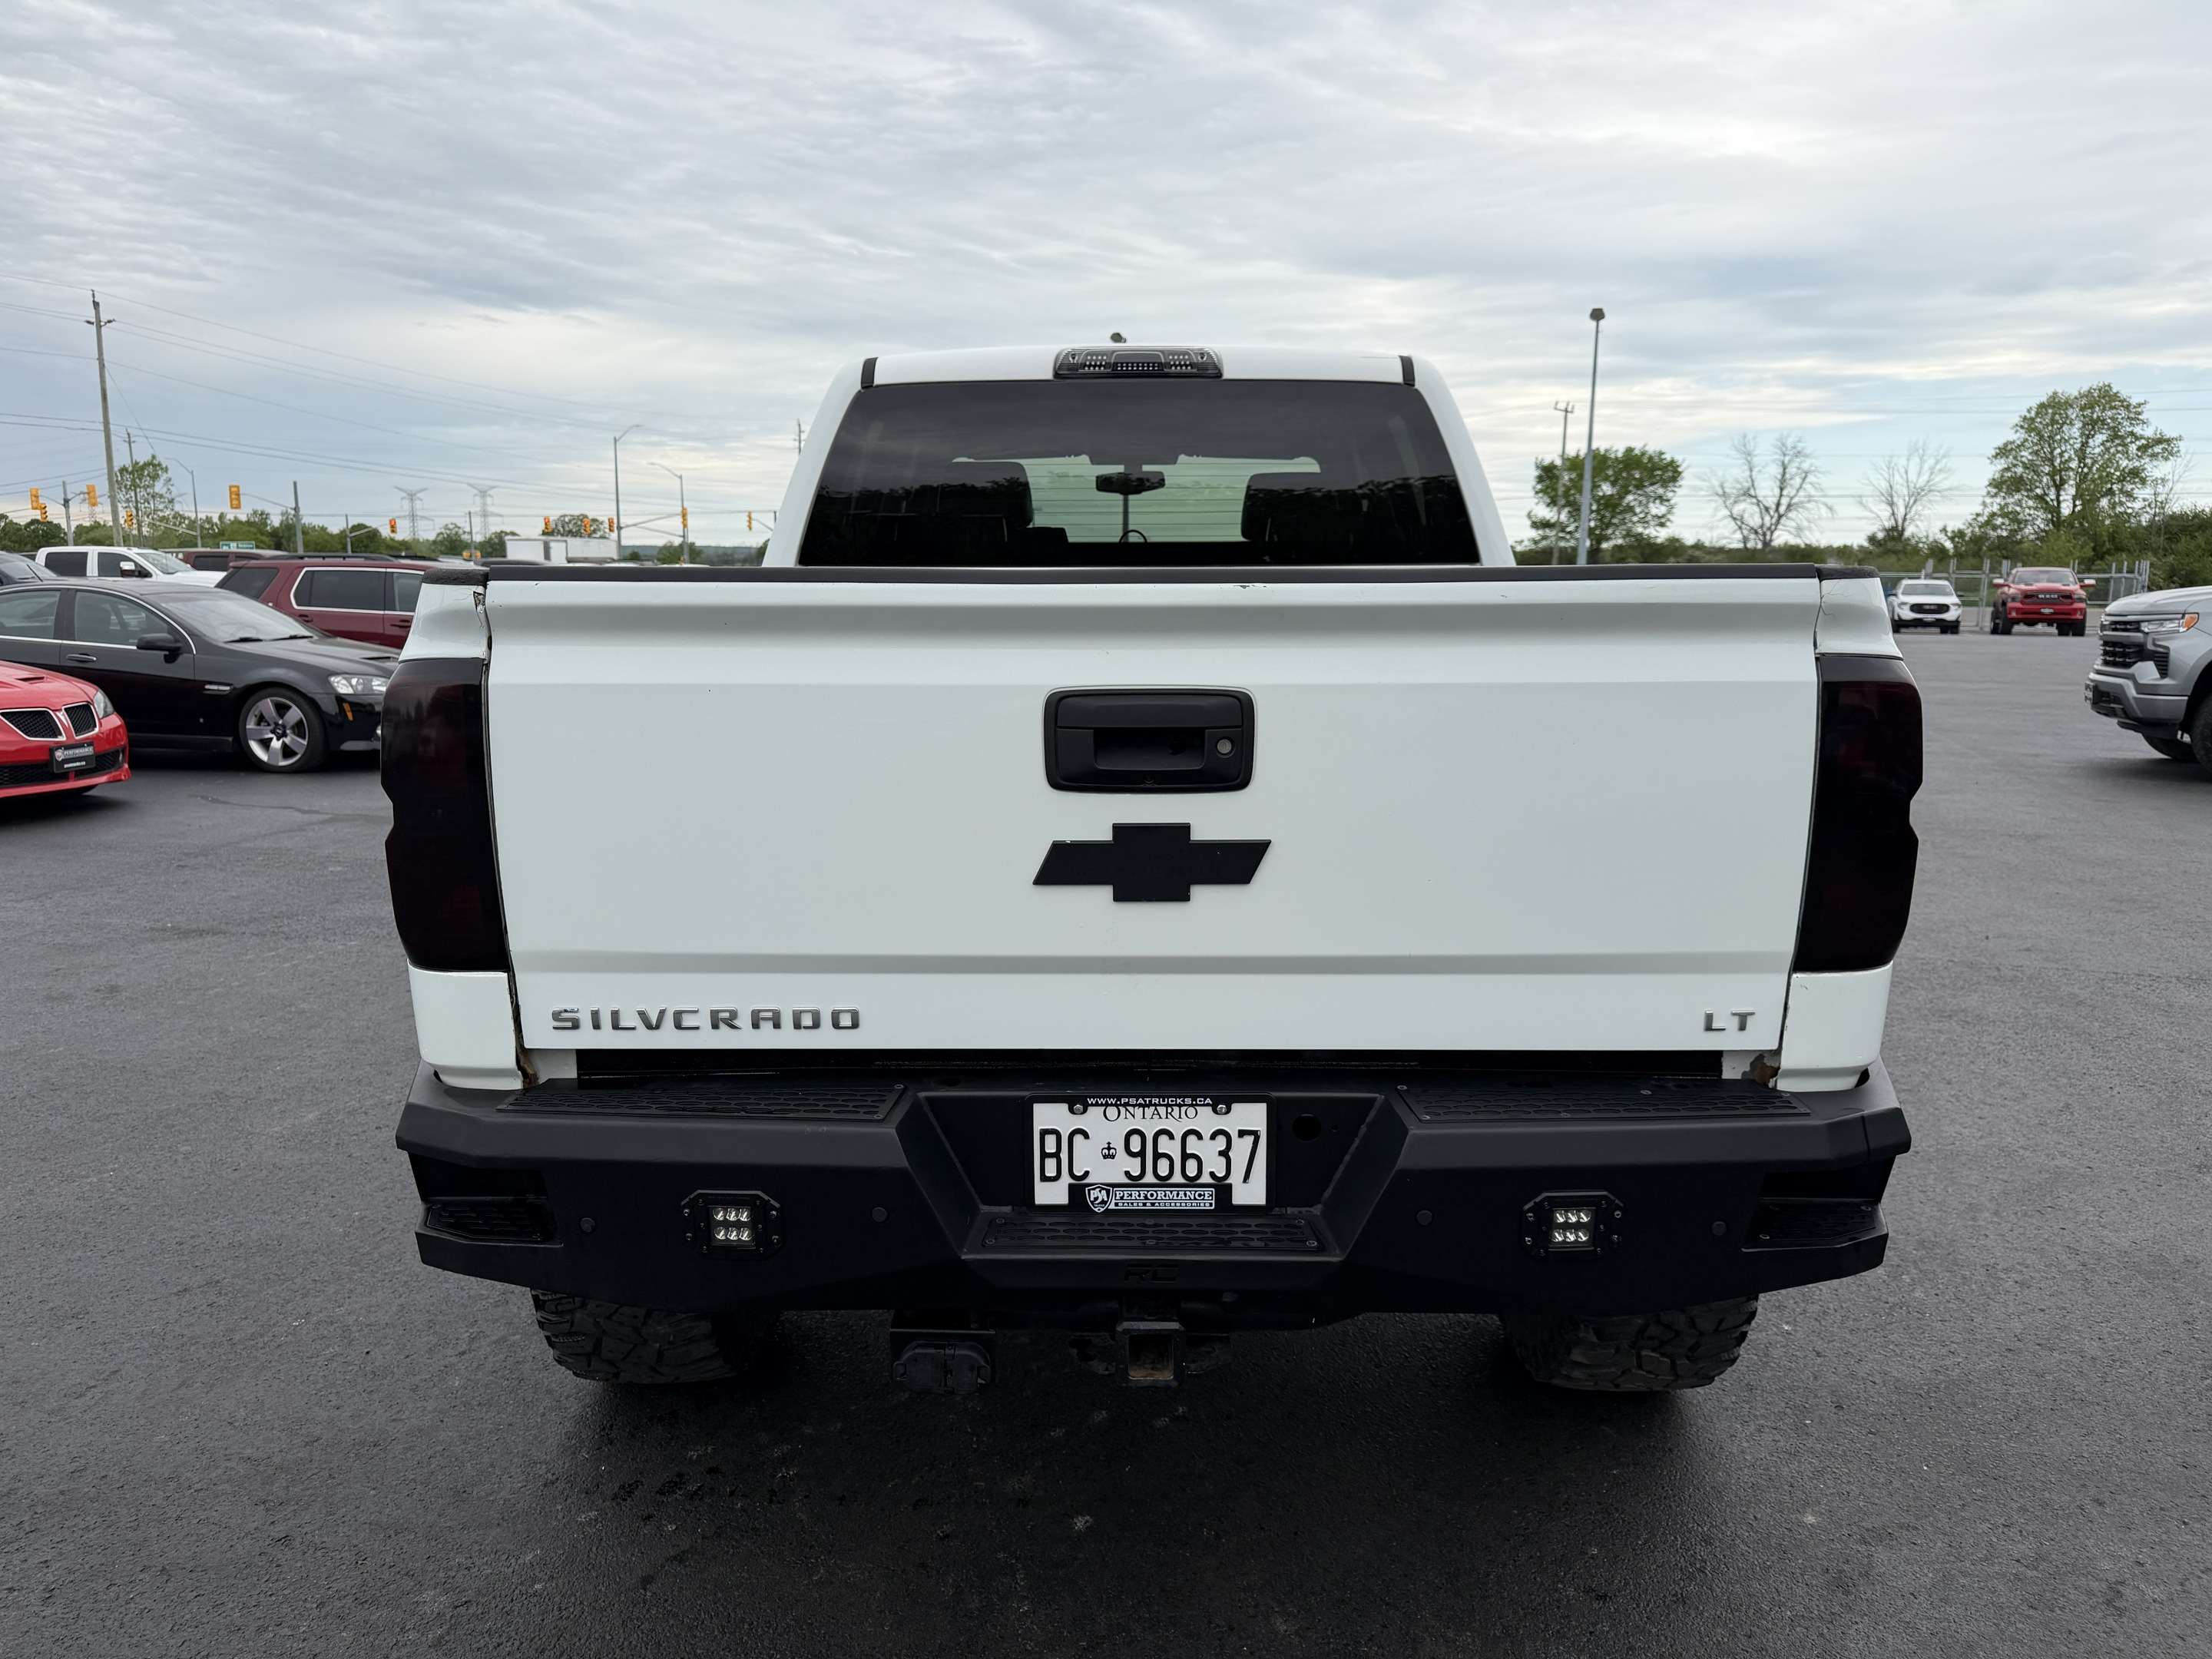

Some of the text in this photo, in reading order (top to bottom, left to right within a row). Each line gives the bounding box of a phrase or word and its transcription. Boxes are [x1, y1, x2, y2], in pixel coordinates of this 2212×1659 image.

[1704, 1009, 1756, 1031] LT
[1103, 1106, 1198, 1122] ONTARIO
[1039, 1128, 1261, 1183] BC 96637
[1115, 1190, 1212, 1200] PERFORMANCE
